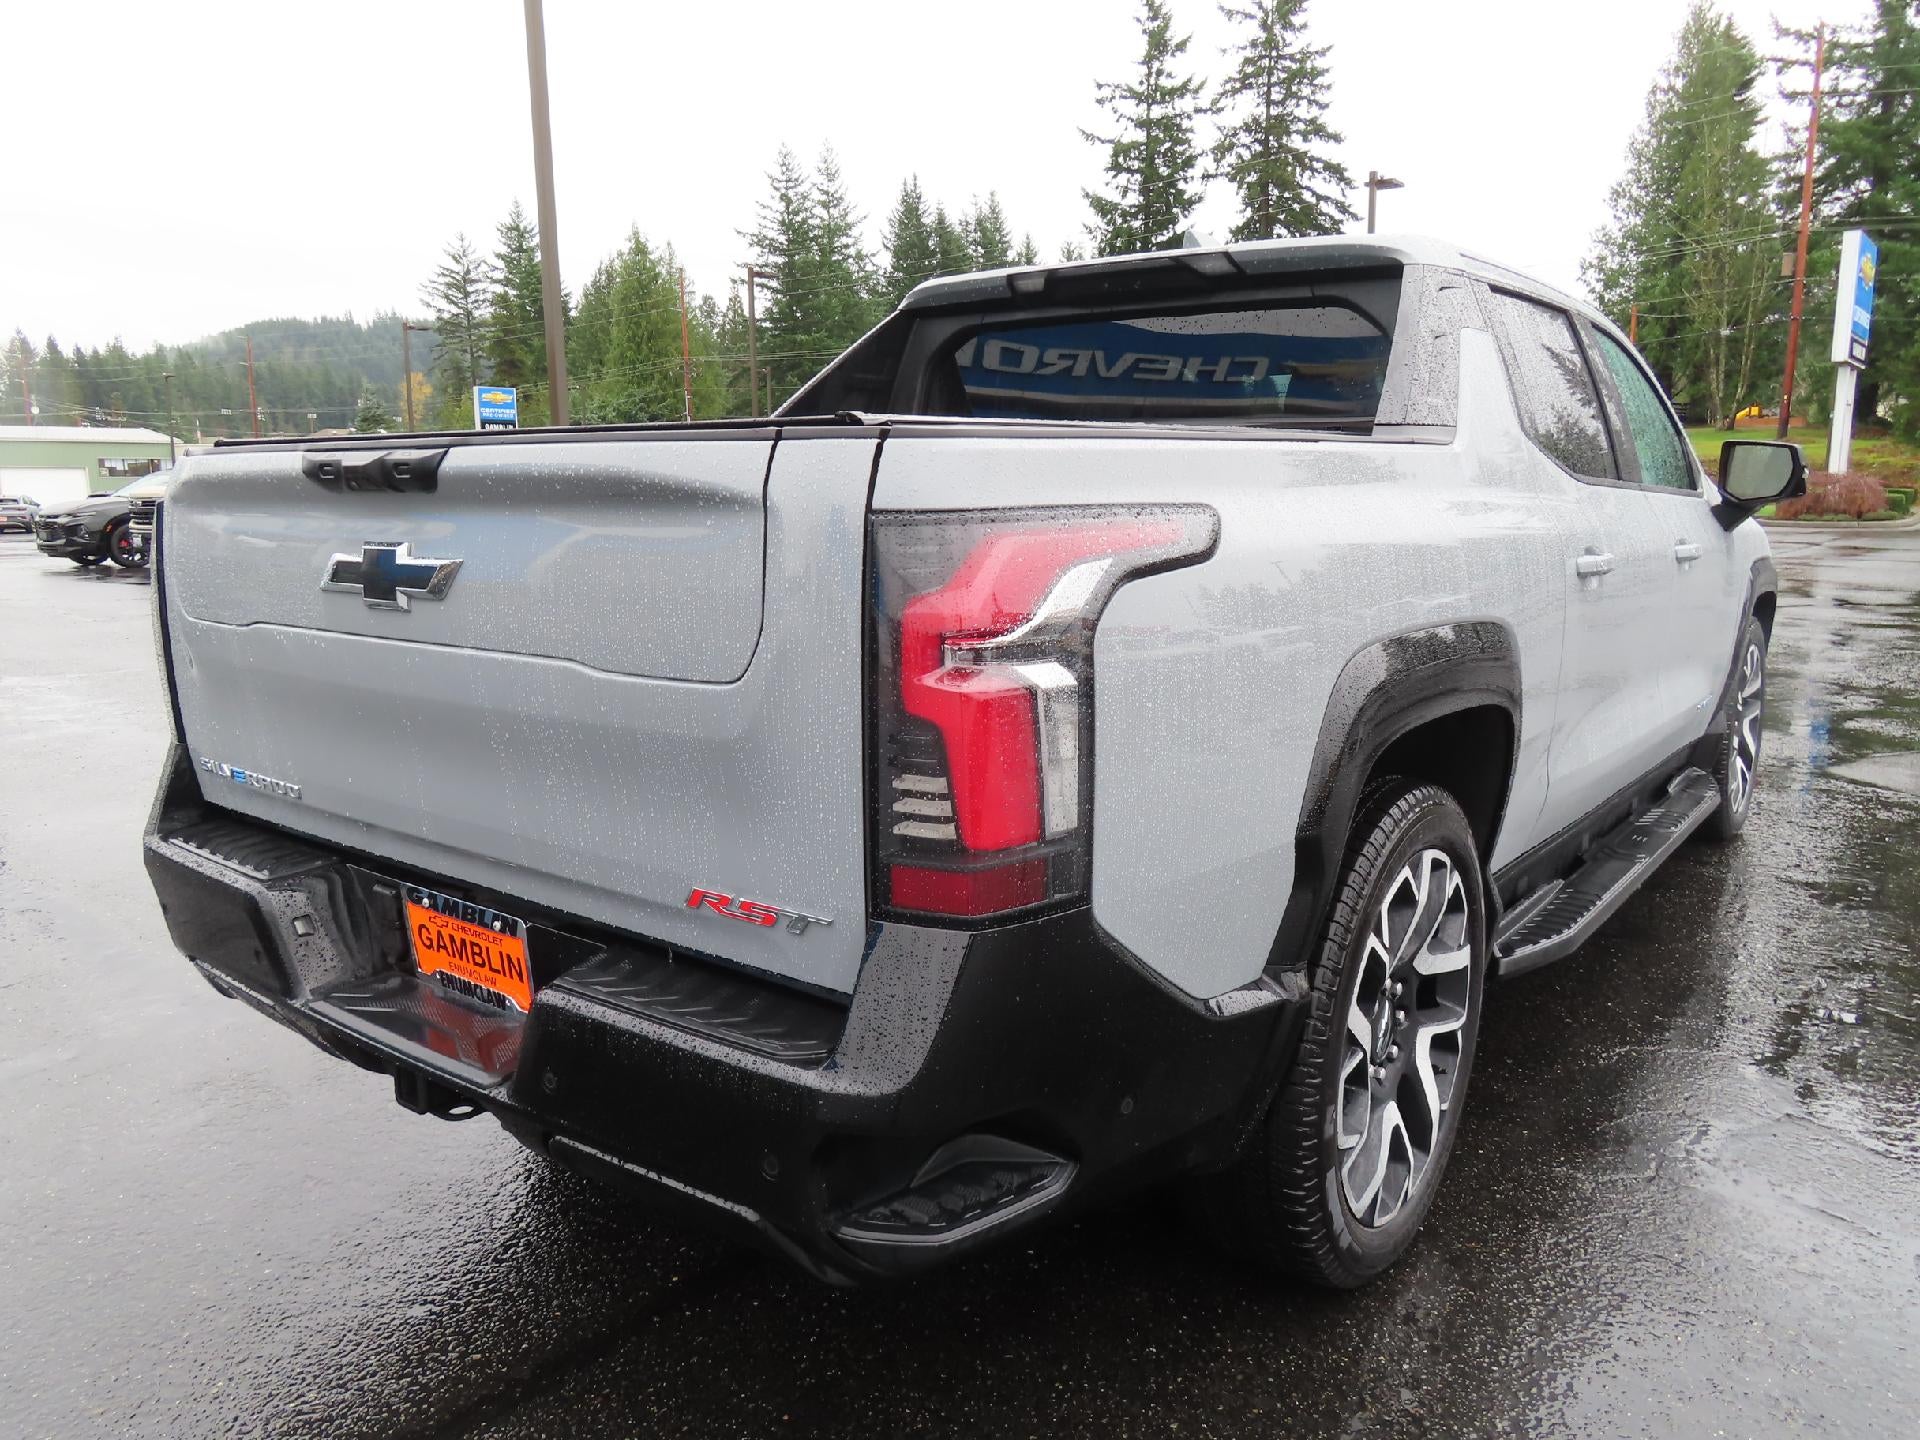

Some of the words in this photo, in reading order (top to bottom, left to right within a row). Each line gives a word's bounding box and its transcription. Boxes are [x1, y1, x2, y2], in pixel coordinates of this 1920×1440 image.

[451, 922, 503, 947] CHEVROLET
[687, 887, 834, 935] RST
[417, 924, 525, 984] GAMBLIN
